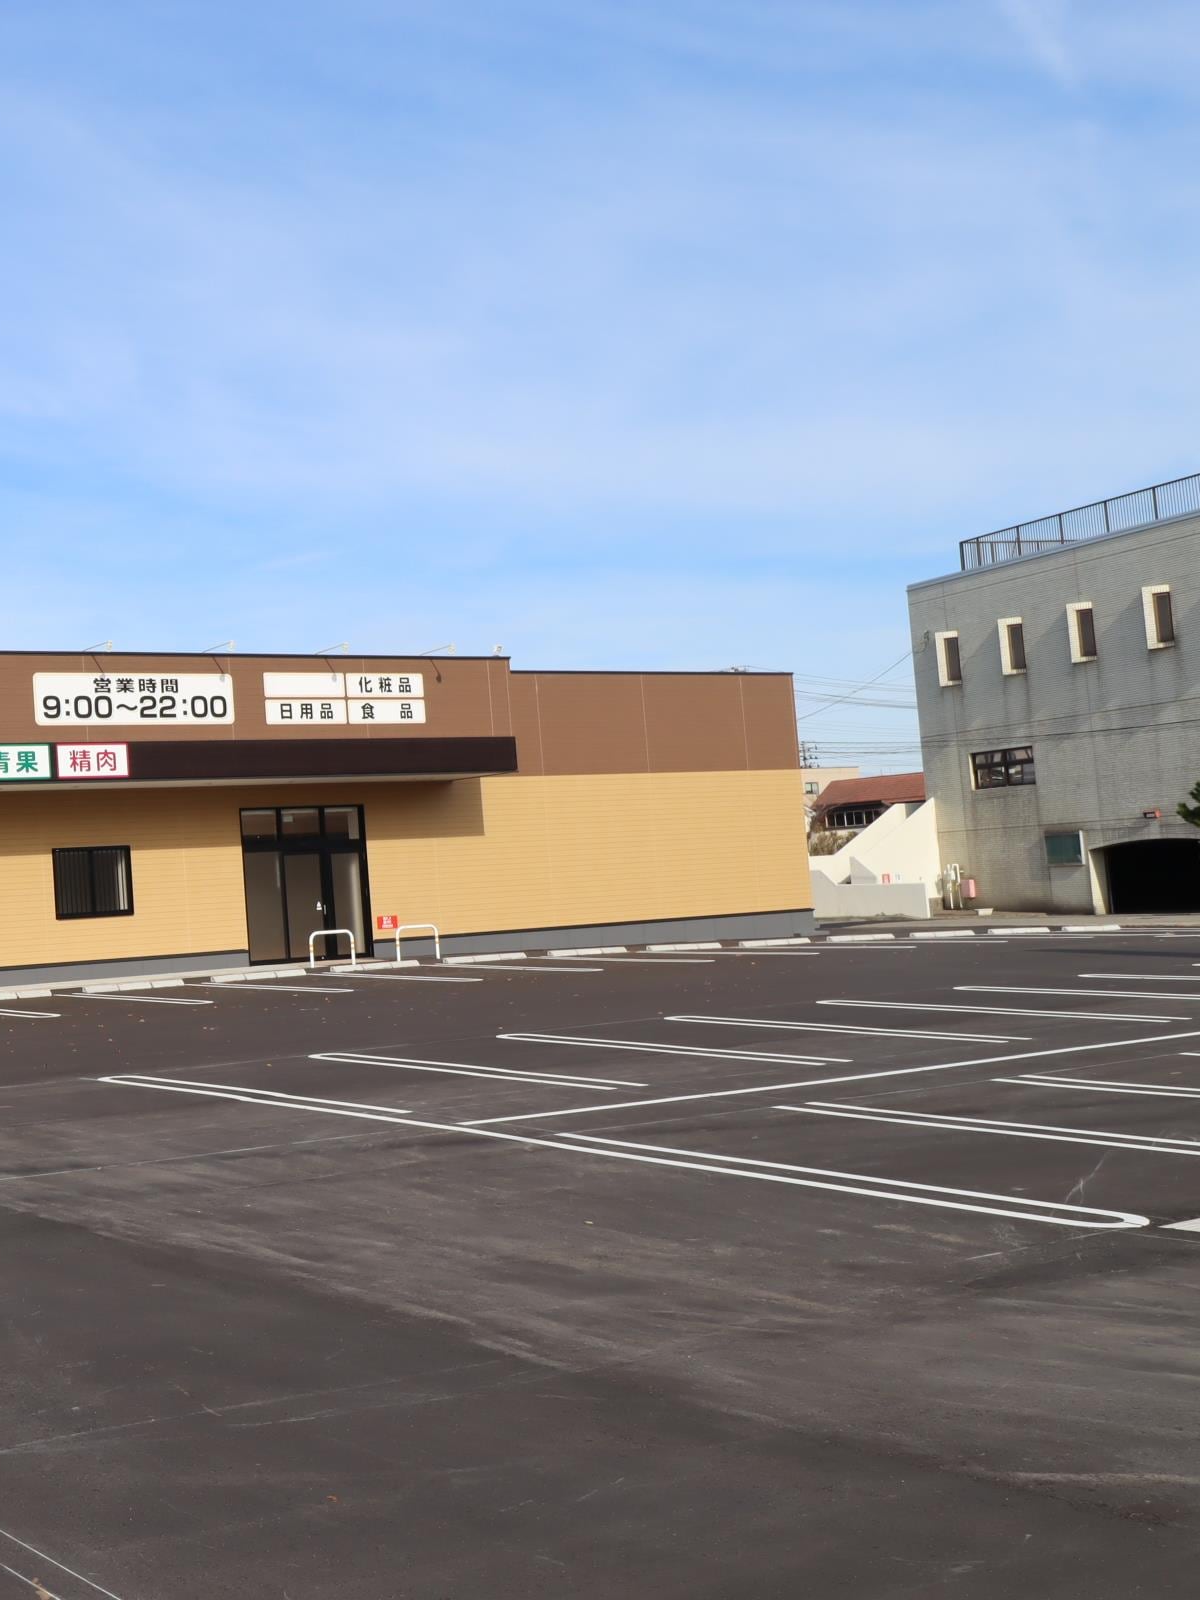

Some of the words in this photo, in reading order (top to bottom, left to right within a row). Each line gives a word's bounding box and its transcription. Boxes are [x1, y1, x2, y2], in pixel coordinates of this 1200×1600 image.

[93, 678, 179, 694] 営業時間
[358, 676, 412, 693] 化粧品
[280, 703, 334, 720] 日用品
[69, 749, 117, 772] 精肉
